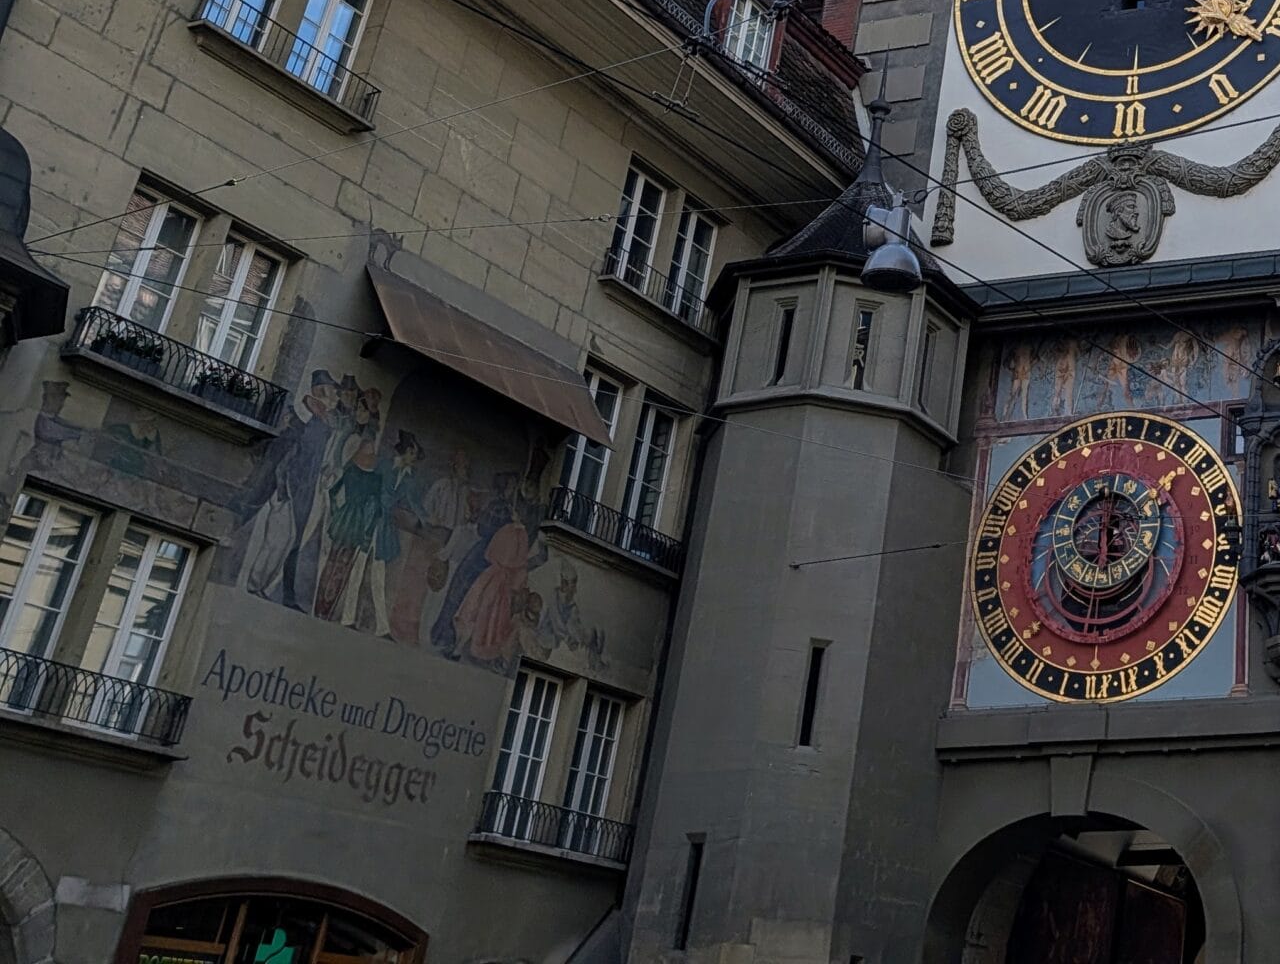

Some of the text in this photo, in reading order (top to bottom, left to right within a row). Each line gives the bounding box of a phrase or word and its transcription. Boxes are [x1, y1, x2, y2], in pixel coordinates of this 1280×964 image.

[969, 31, 1015, 85] VIII
[1208, 73, 1240, 106] V
[1020, 84, 1068, 129] VII
[1113, 101, 1147, 138] VI
[1076, 423, 1095, 448] XI
[1102, 418, 1127, 439] XII
[1140, 419, 1150, 440] I
[1163, 427, 1182, 450] II
[1048, 437, 1061, 461] X
[1183, 443, 1207, 469] III
[1017, 453, 1042, 479] IX
[1200, 463, 1227, 494] IIII
[994, 480, 1023, 512] VIII
[982, 513, 1007, 538] VII
[976, 543, 998, 571] VI
[1209, 564, 1236, 590] VII
[983, 606, 1009, 637] IIII
[1193, 595, 1224, 628] VIII
[1000, 636, 1024, 666] III
[1025, 658, 1046, 684] II
[201, 648, 488, 759] Apotheke und Drogerie
[226, 710, 438, 805] Scheidegger
